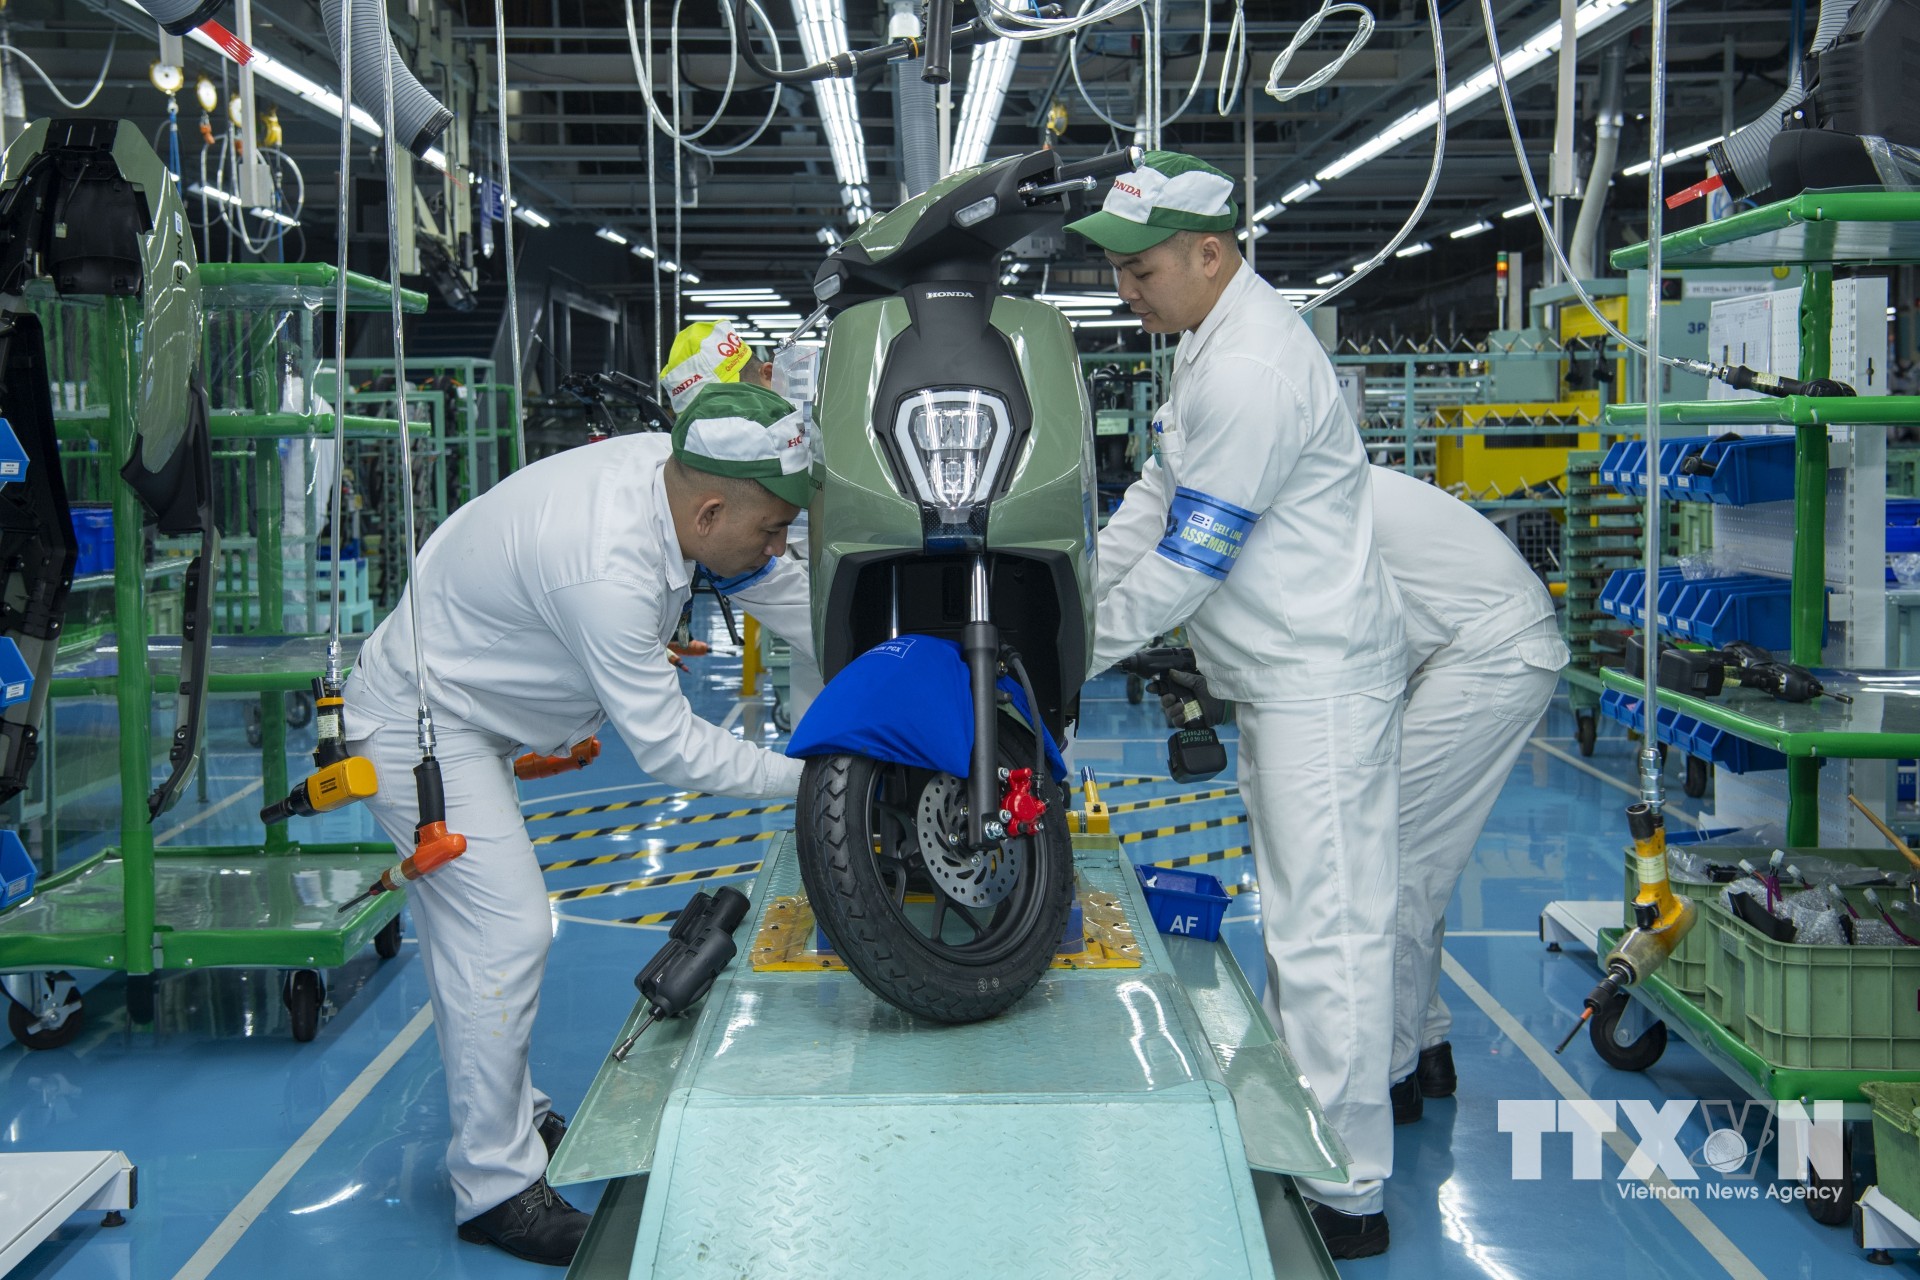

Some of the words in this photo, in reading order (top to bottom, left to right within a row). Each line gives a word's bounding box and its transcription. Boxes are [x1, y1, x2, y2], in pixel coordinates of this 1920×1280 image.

[1113, 180, 1142, 198] ONDA
[926, 291, 975, 299] HONDA
[672, 374, 703, 396] ONDA
[1212, 523, 1230, 537] CELL
[1180, 526, 1236, 557] ASSEMBLY
[1169, 914, 1199, 934] AF
